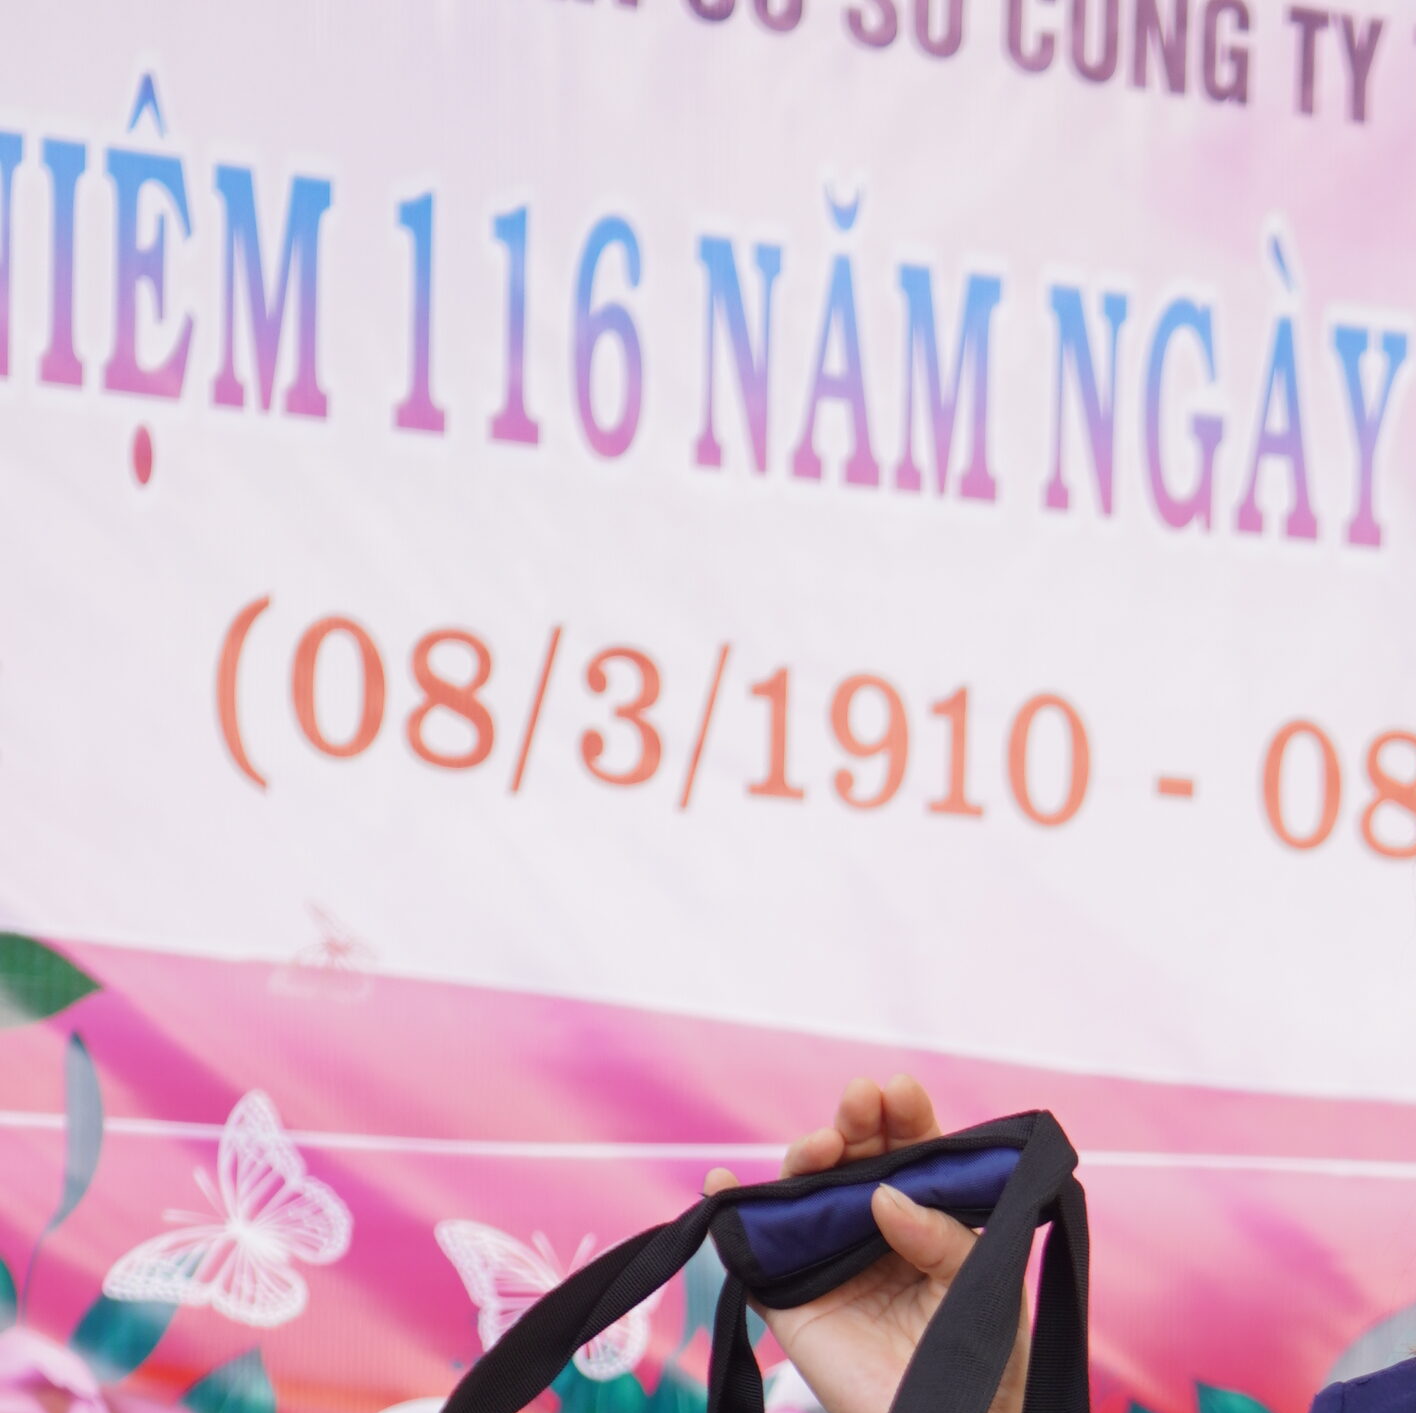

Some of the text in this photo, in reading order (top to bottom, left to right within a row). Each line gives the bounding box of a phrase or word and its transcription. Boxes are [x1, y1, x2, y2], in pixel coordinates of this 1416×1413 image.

[1290, 6, 1384, 123] TY
[396, 191, 642, 460] 116
[696, 180, 1001, 503] NĂM
[1044, 236, 1407, 547] NGÀY
[215, 595, 1092, 828] (08/3/1910
